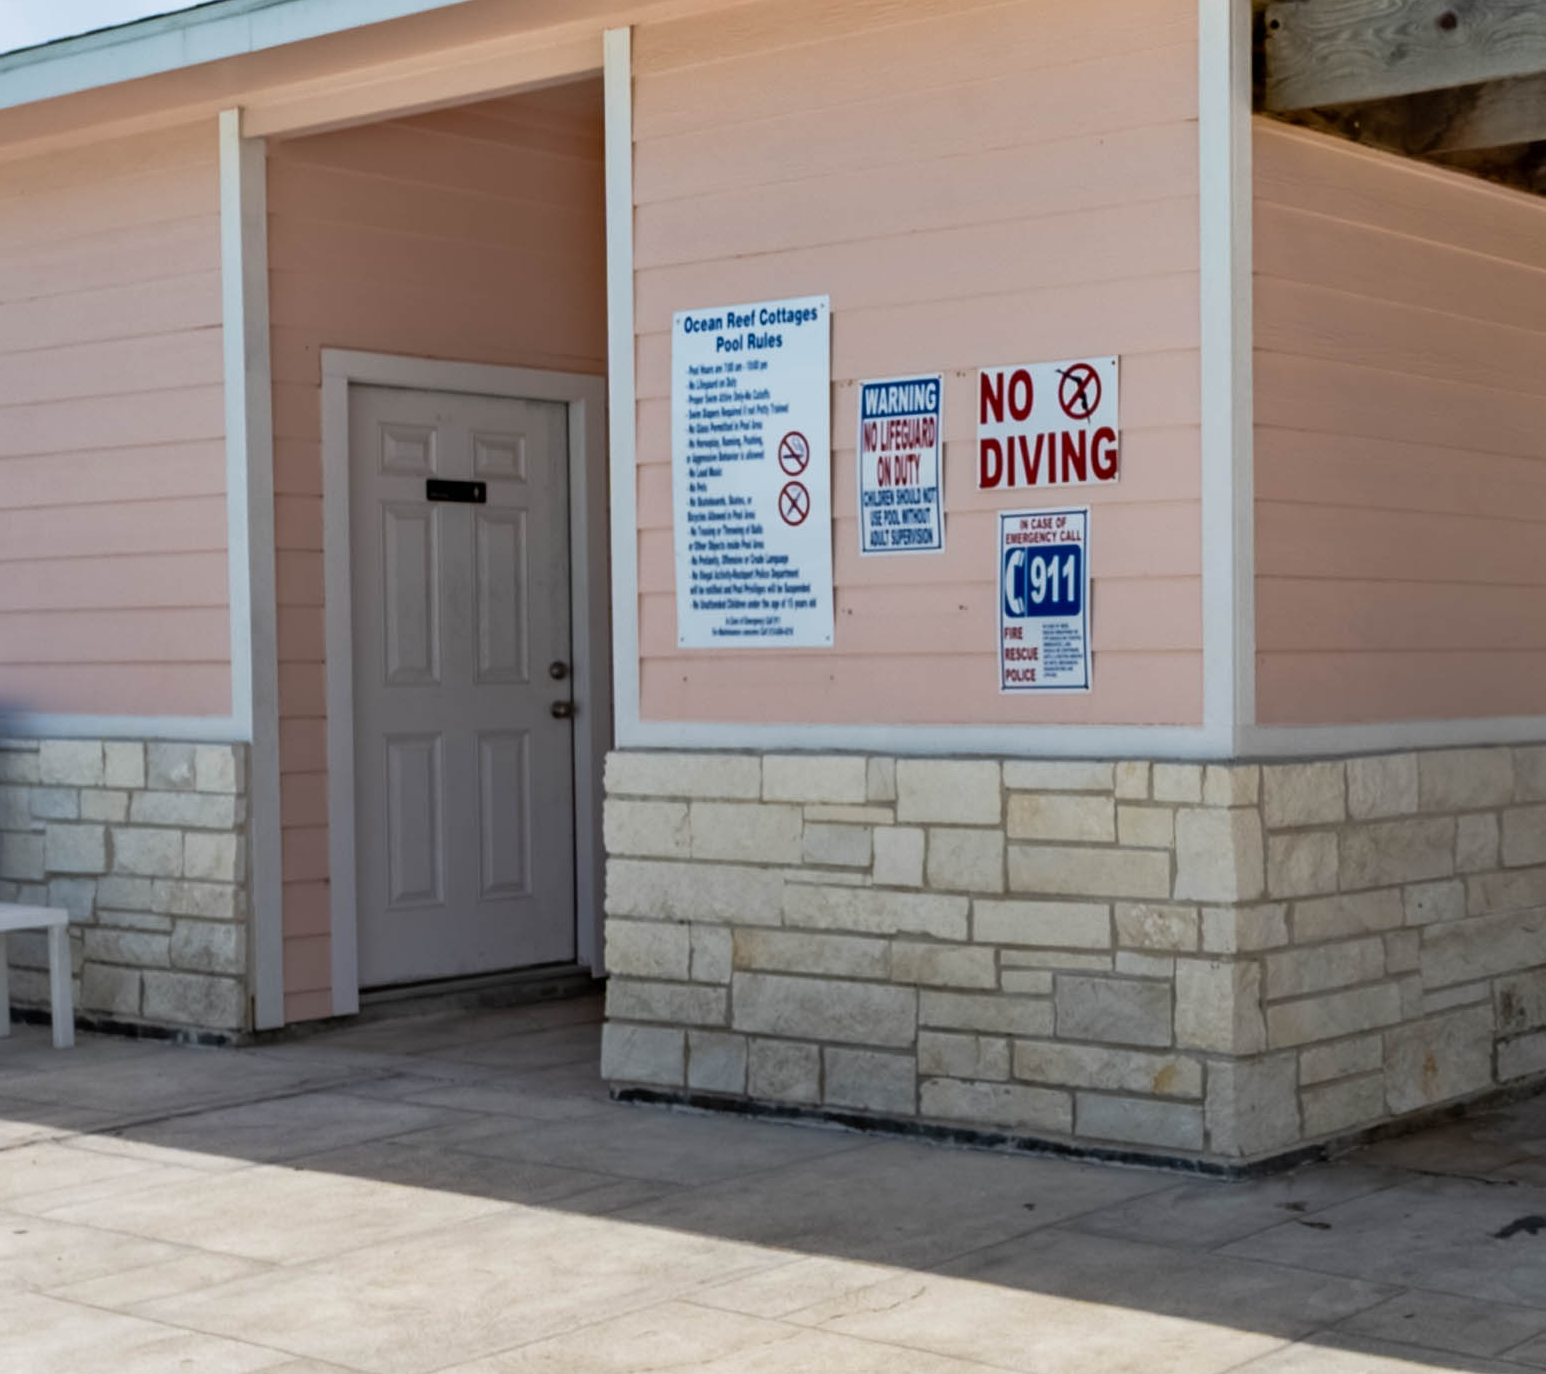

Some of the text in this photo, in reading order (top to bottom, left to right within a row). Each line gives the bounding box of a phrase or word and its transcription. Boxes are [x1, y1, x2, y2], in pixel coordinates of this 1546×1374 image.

[684, 308, 817, 333] Ocean Reef Cottages
[717, 333, 782, 353] Pool Rules
[866, 383, 936, 416] WARNING
[980, 368, 1034, 424] NO
[864, 417, 935, 452] NO LIFEGUARD
[979, 426, 1117, 489] DIVING
[878, 453, 920, 487] ON DUTY
[864, 487, 936, 506] CHILDREN SHOULD NOT
[871, 507, 930, 526] USE POOL WITHOUT
[1020, 517, 1066, 530] IN CASE OF
[870, 528, 933, 546] ADULT SUPERVISION
[1006, 530, 1081, 544] EMERGENCY CALL
[1031, 555, 1075, 604] 911
[1004, 626, 1022, 640] FIRE
[1005, 647, 1038, 660] RESCUE
[1006, 668, 1036, 682] POLICE
